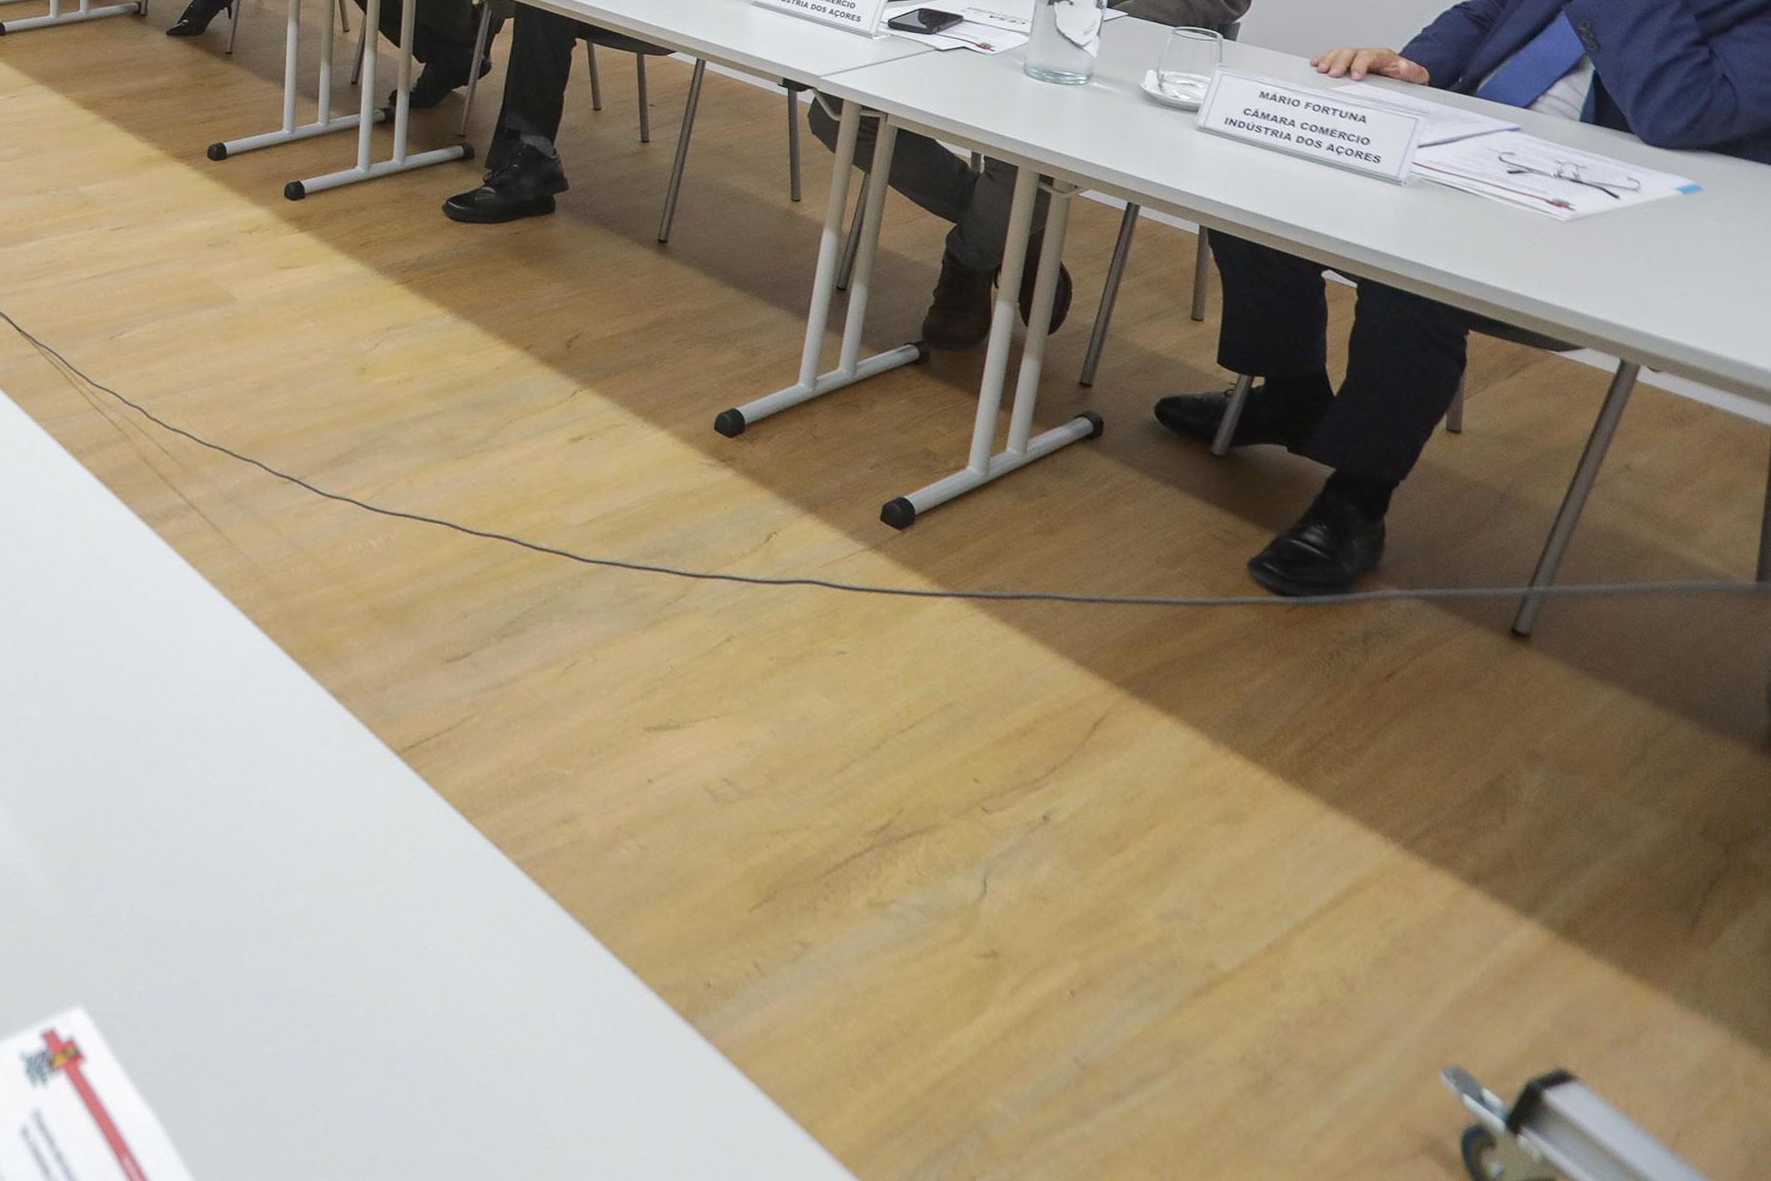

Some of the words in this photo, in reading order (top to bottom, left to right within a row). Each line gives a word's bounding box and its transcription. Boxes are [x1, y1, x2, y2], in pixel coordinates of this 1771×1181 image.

[810, 3, 827, 13] DOS
[828, 7, 862, 23] AÇORES
[1258, 89, 1301, 108] MÁRIO
[1303, 101, 1367, 124] FORTUNA
[1299, 120, 1371, 146] COMÉRCIO
[1295, 134, 1323, 149] DOS
[1325, 141, 1382, 164] AÇORES
